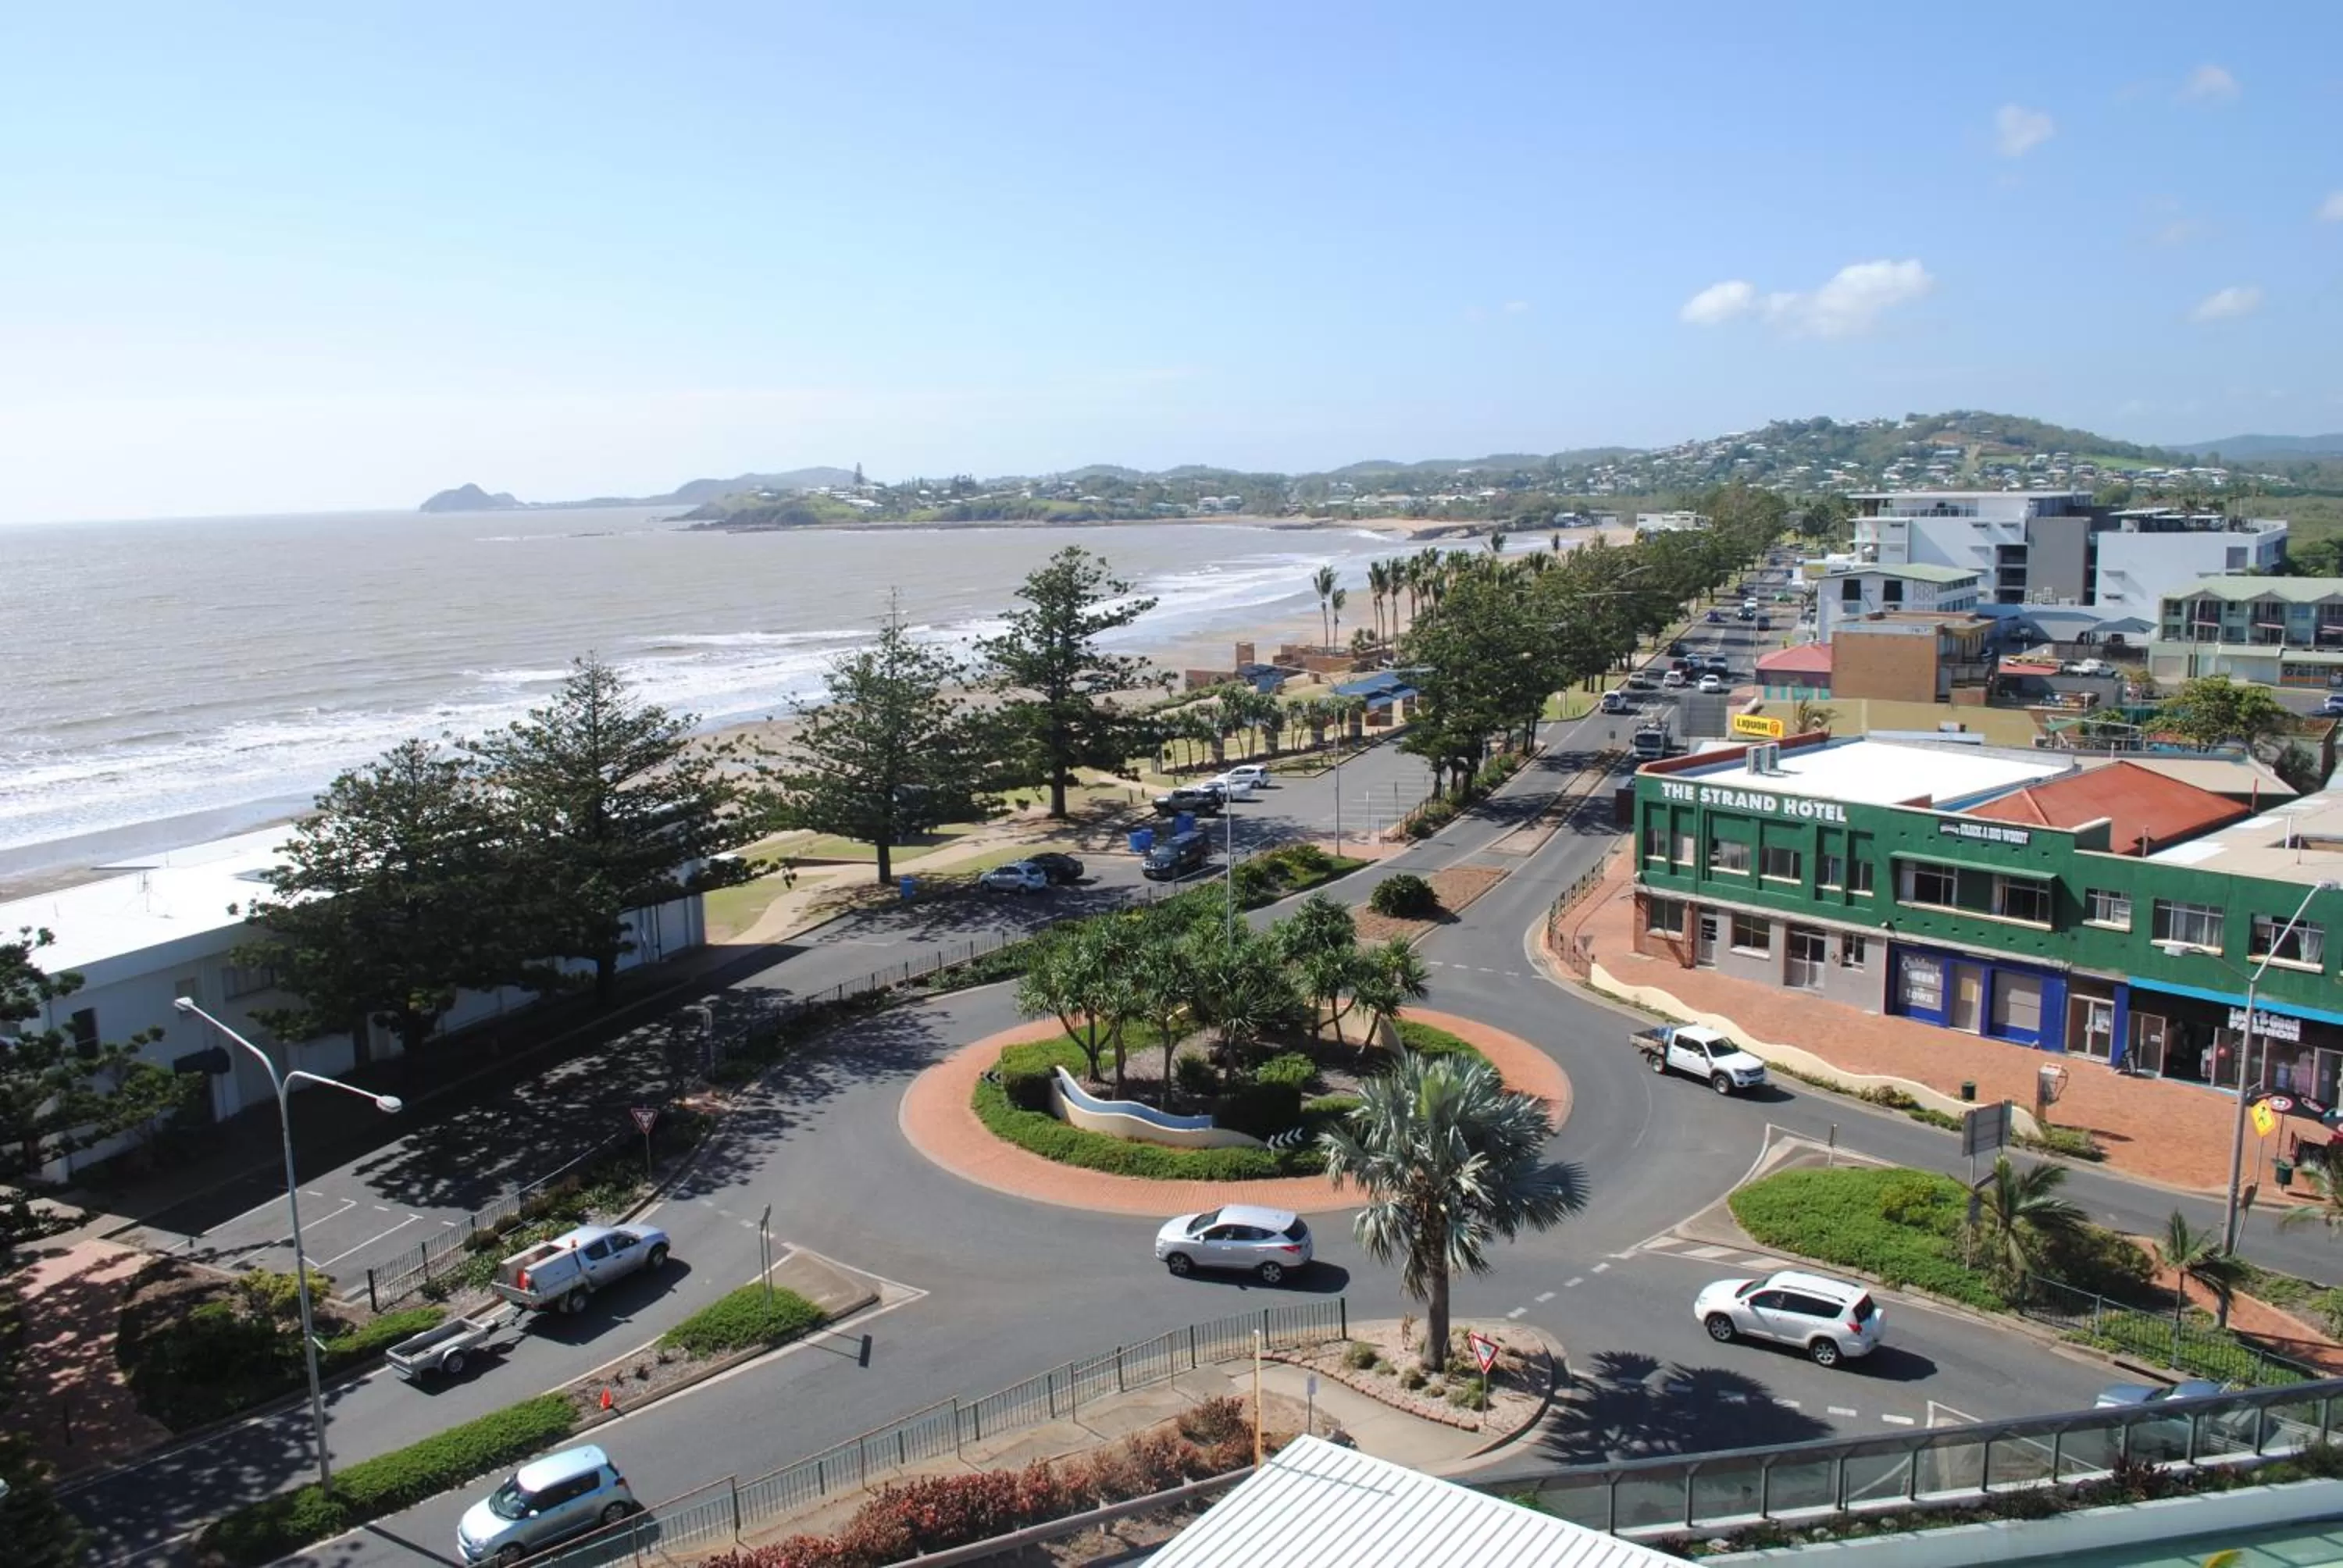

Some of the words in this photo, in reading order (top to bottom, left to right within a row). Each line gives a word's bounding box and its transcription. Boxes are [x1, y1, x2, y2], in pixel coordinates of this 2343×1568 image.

[1736, 718, 1768, 732] LIQUOR
[1661, 781, 1694, 801] THE
[1699, 786, 1778, 812] STRAND
[1783, 797, 1848, 823] HOTEL
